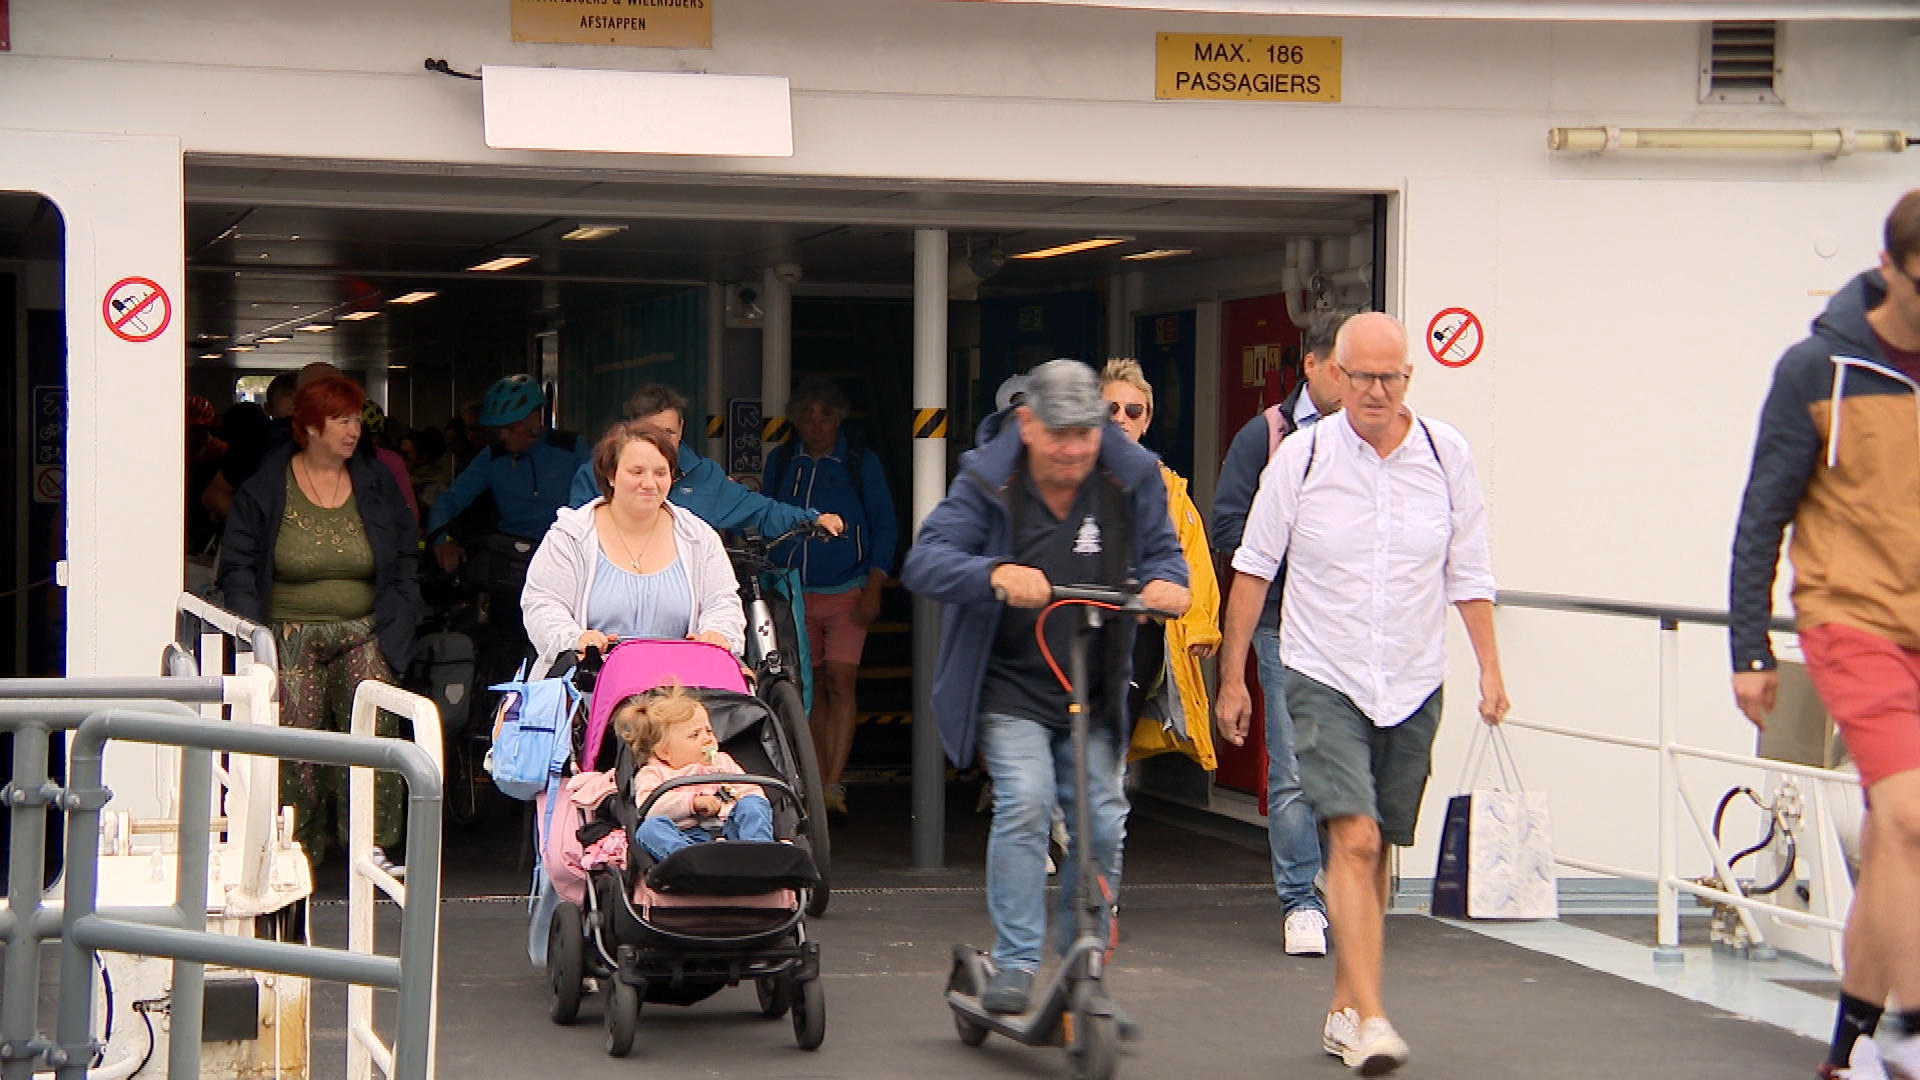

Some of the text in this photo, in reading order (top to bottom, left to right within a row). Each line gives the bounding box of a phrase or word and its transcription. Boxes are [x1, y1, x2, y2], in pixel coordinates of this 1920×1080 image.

[580, 15, 646, 31] AFSTAPPEN
[1194, 42, 1304, 65] MAX. 186
[1176, 71, 1321, 95] PASSAGIERS
